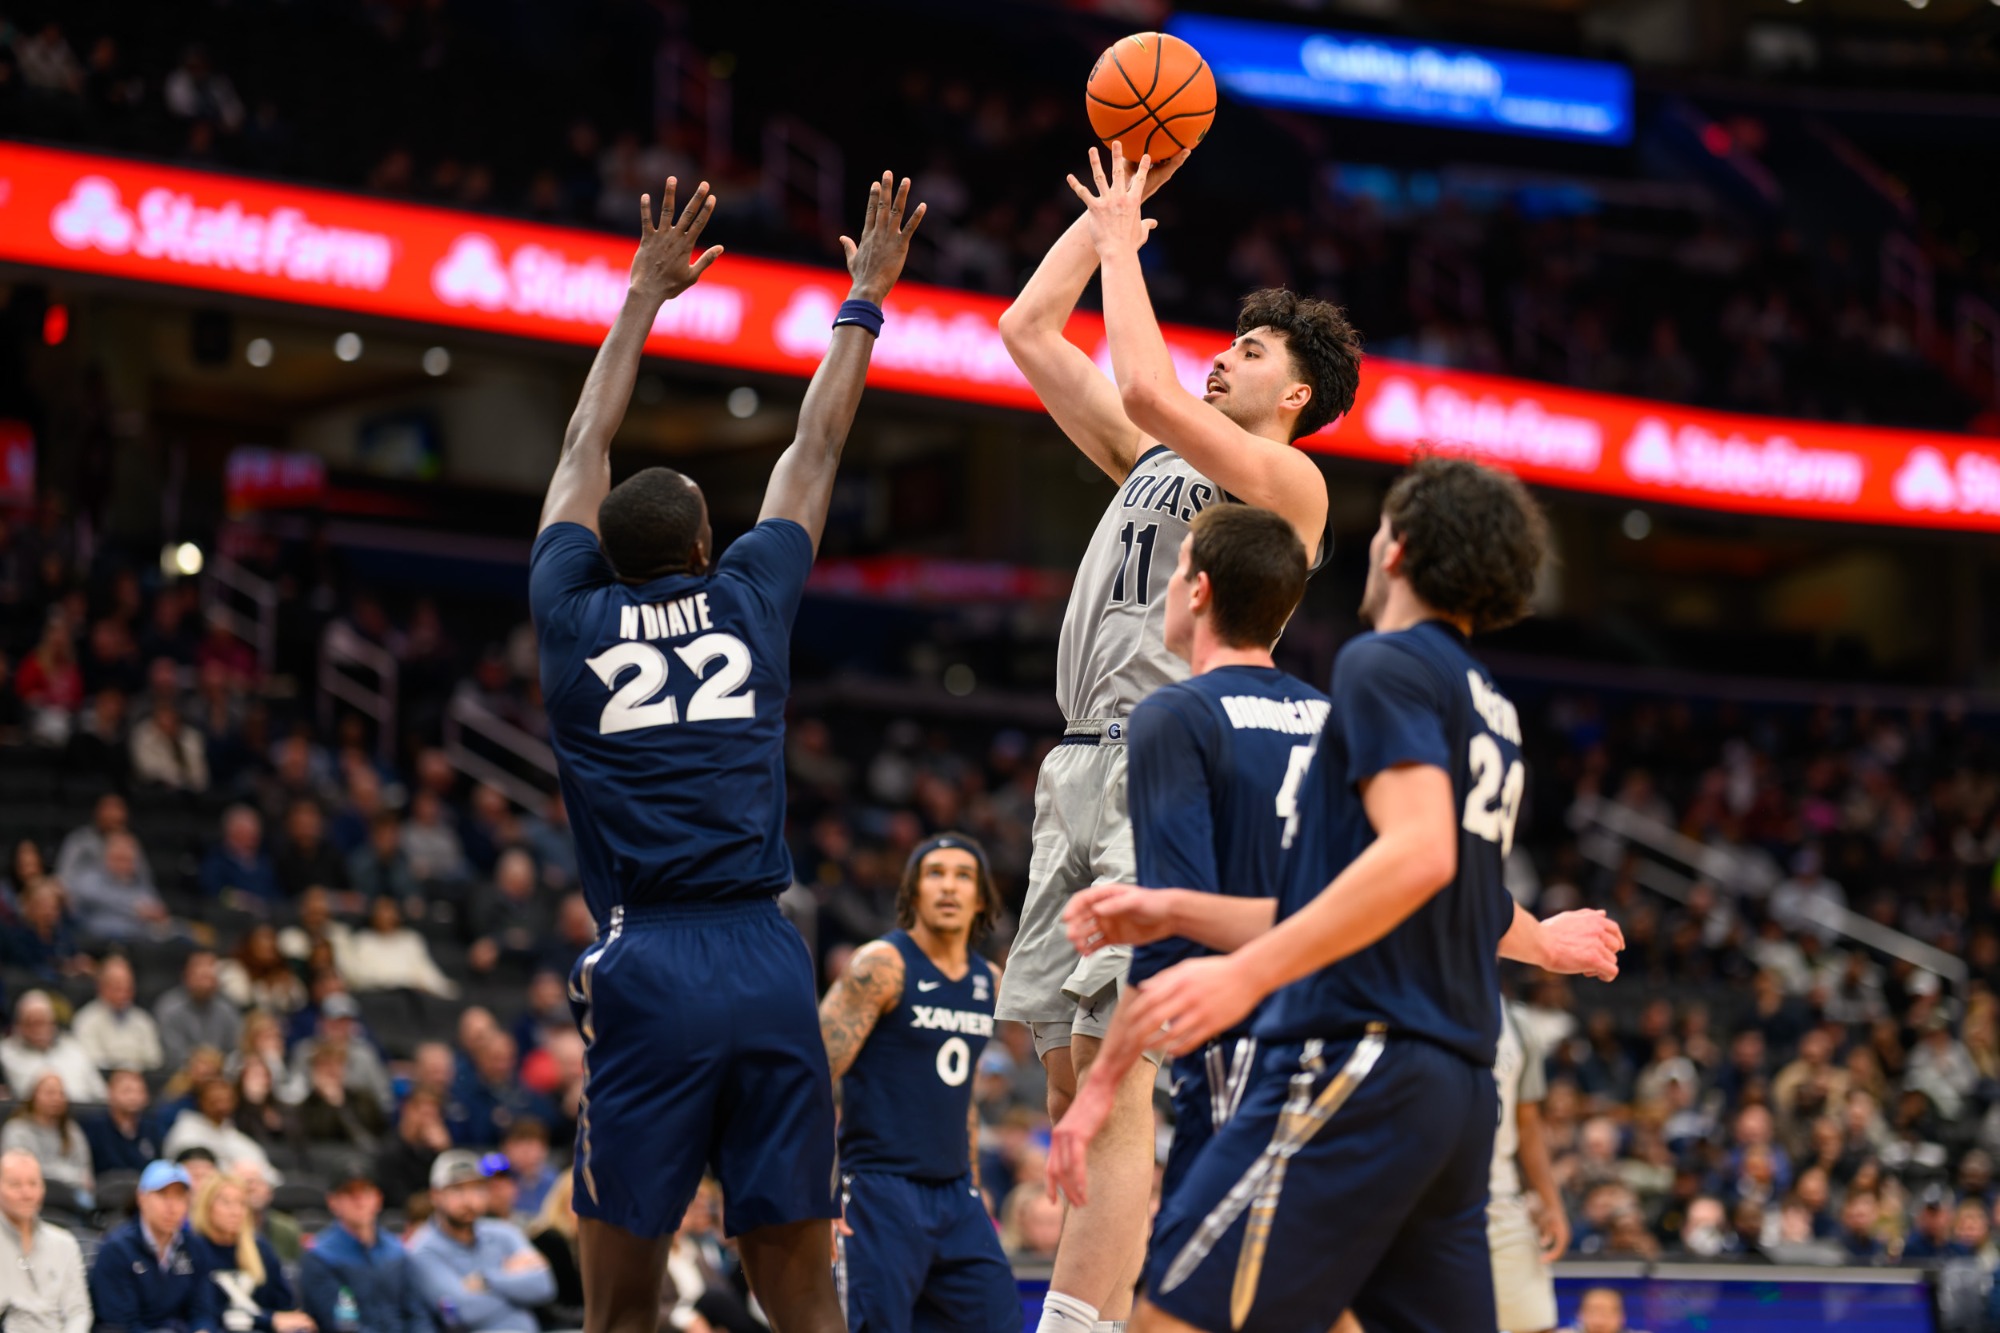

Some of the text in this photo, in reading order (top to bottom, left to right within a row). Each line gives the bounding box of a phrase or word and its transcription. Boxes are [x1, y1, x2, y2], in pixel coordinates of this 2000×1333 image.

[1122, 474, 1213, 523] OYAS
[1111, 520, 1159, 606] 11
[584, 633, 756, 735] 22
[1107, 722, 1122, 740] G
[910, 1005, 994, 1038] XAVIER
[936, 1036, 970, 1087] 0
